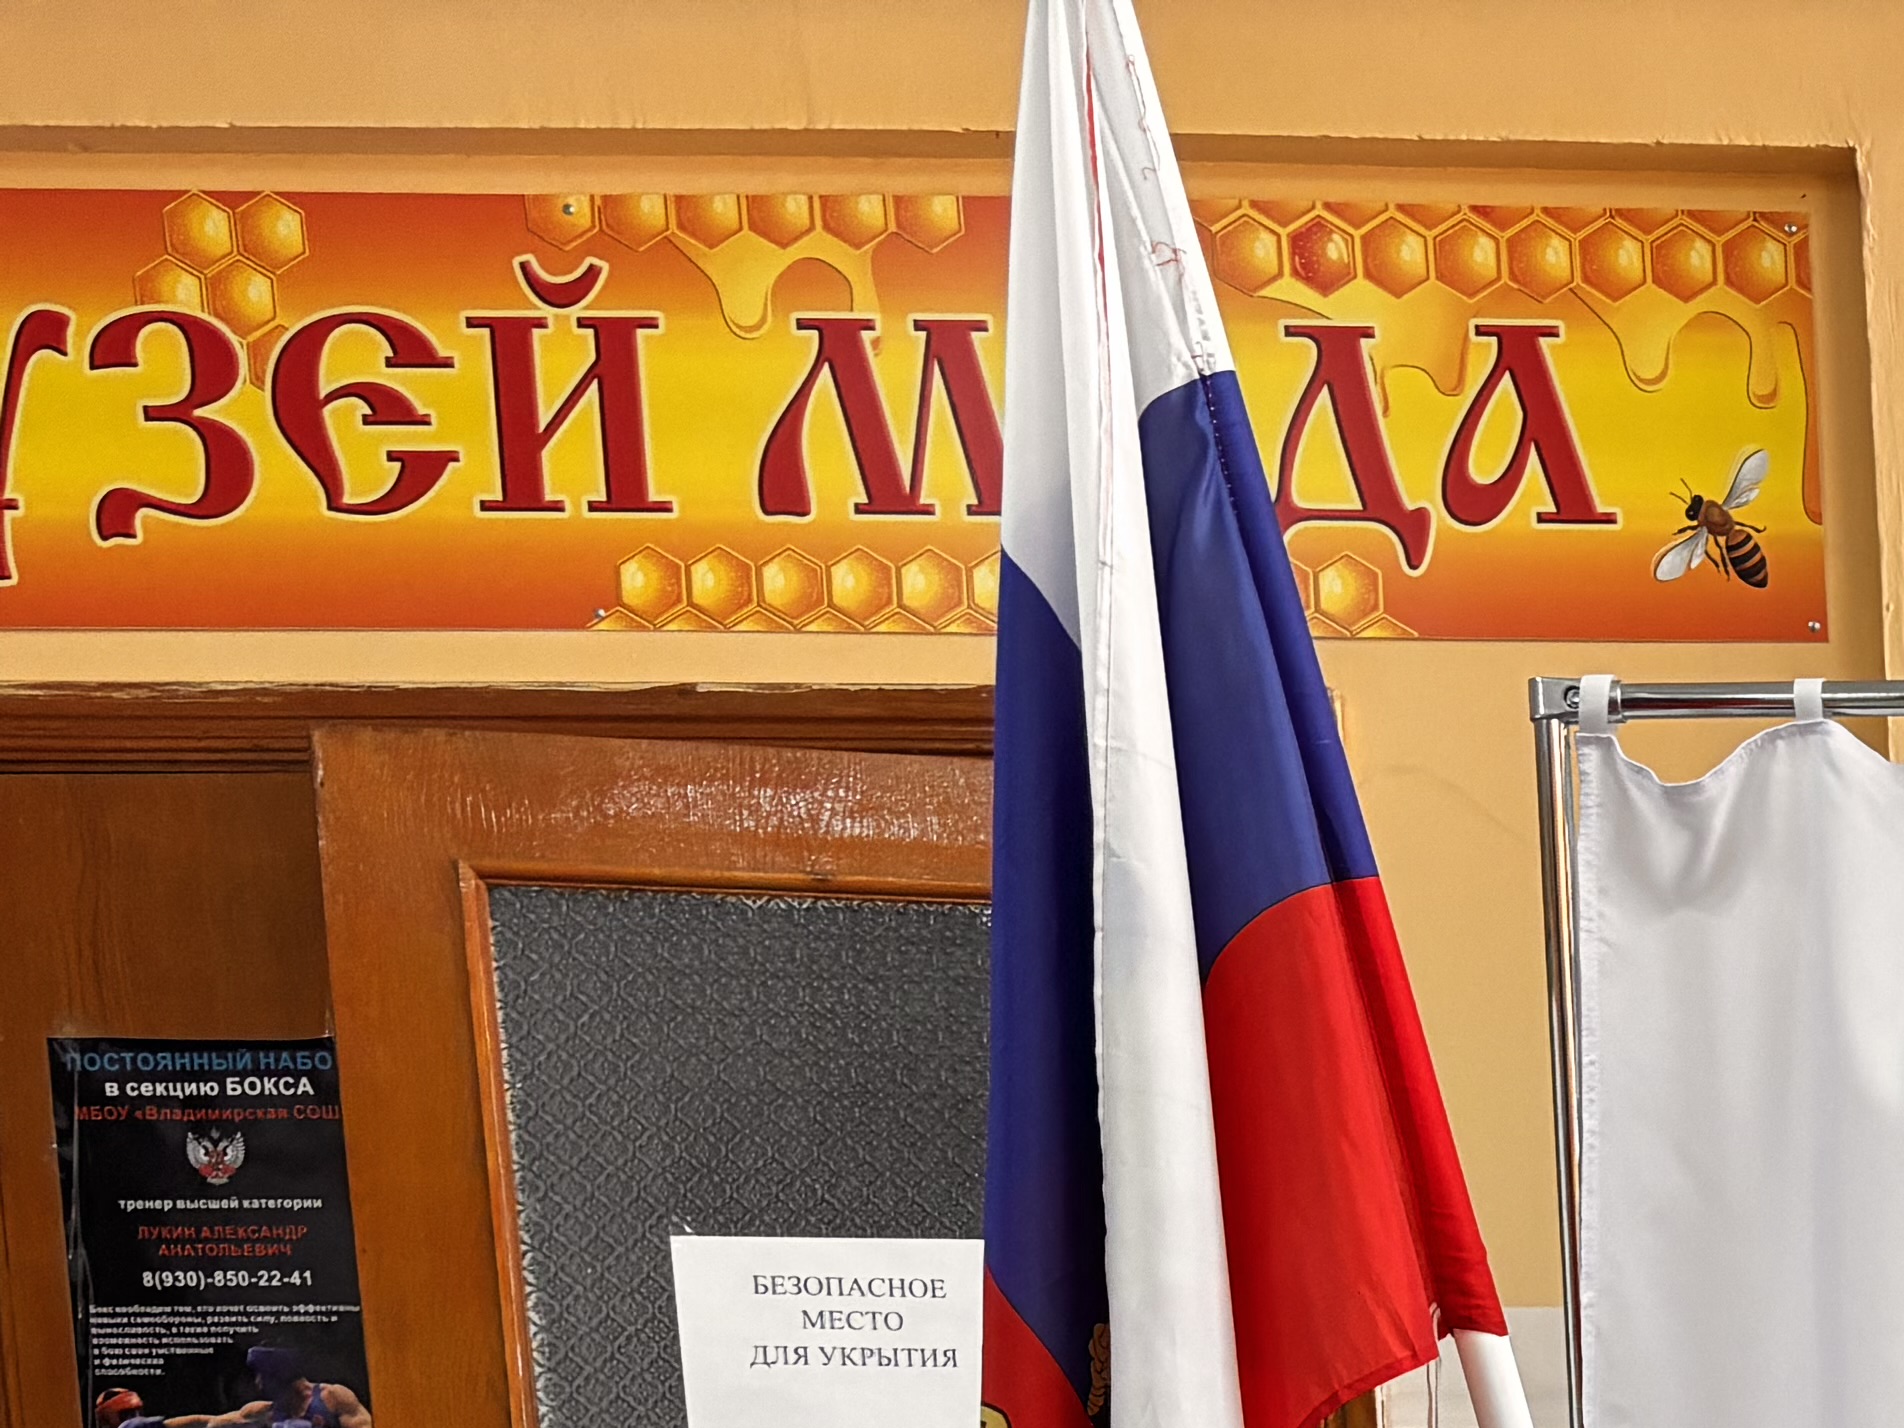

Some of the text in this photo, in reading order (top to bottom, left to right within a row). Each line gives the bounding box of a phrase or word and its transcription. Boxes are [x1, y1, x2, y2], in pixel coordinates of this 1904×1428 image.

[760, 313, 1621, 577] МДА
[66, 1048, 253, 1071] ПОСТОЯННЫЙ
[104, 1076, 315, 1099] в секцию БОКСА
[75, 1105, 129, 1120] МБОУ
[118, 1196, 322, 1212] тренер высшей категории
[138, 1226, 307, 1241] ЛУКИН АЛЕКСАНДР
[158, 1244, 292, 1257] АНАТОЛЬЕВИЧ
[142, 1270, 312, 1290] 8(930)-850-22-41
[752, 1274, 947, 1299] БЕЗОПАСНОЕ
[801, 1309, 904, 1331] МЕСТО
[750, 1344, 958, 1369] ДЛЯ УКРЫТИЯ
